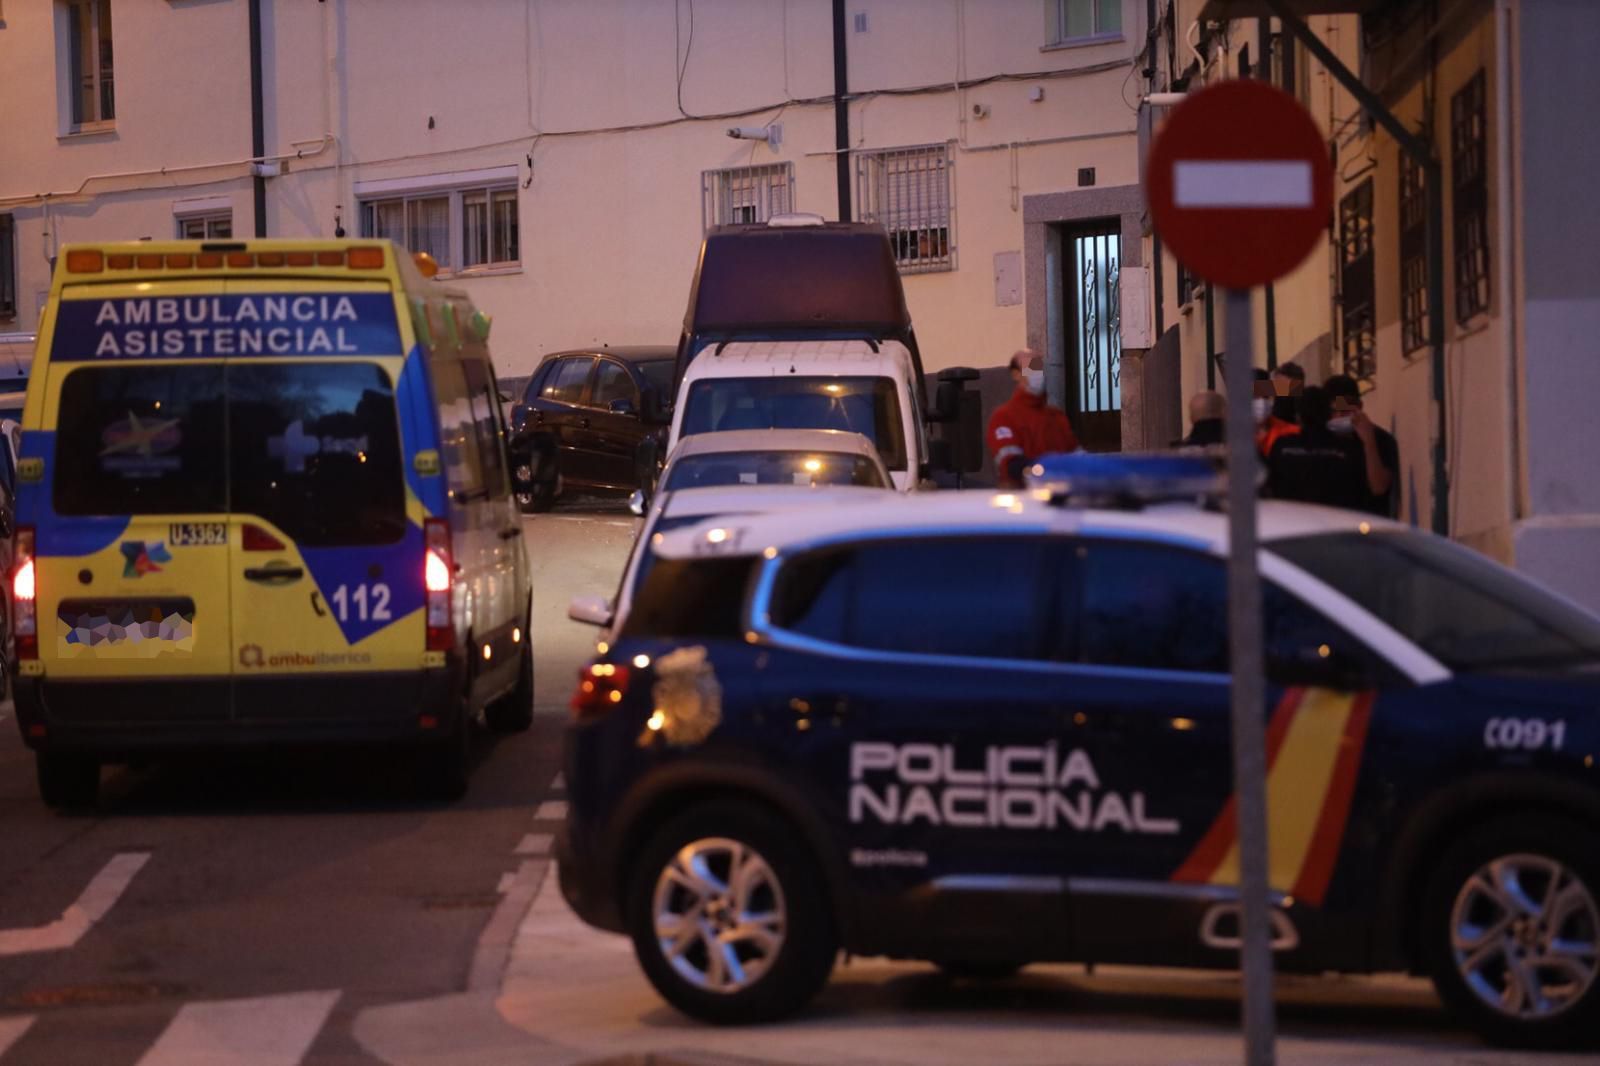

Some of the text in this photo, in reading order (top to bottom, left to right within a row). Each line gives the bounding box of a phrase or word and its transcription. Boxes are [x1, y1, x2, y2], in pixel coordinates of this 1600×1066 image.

[96, 296, 358, 325] AMBULANCIA
[96, 327, 357, 356] ASISTENCIAL
[171, 524, 227, 545] U-3362
[333, 584, 392, 621] 112
[850, 740, 1099, 788] POLICÍA
[850, 785, 1180, 833] NACIONAL
